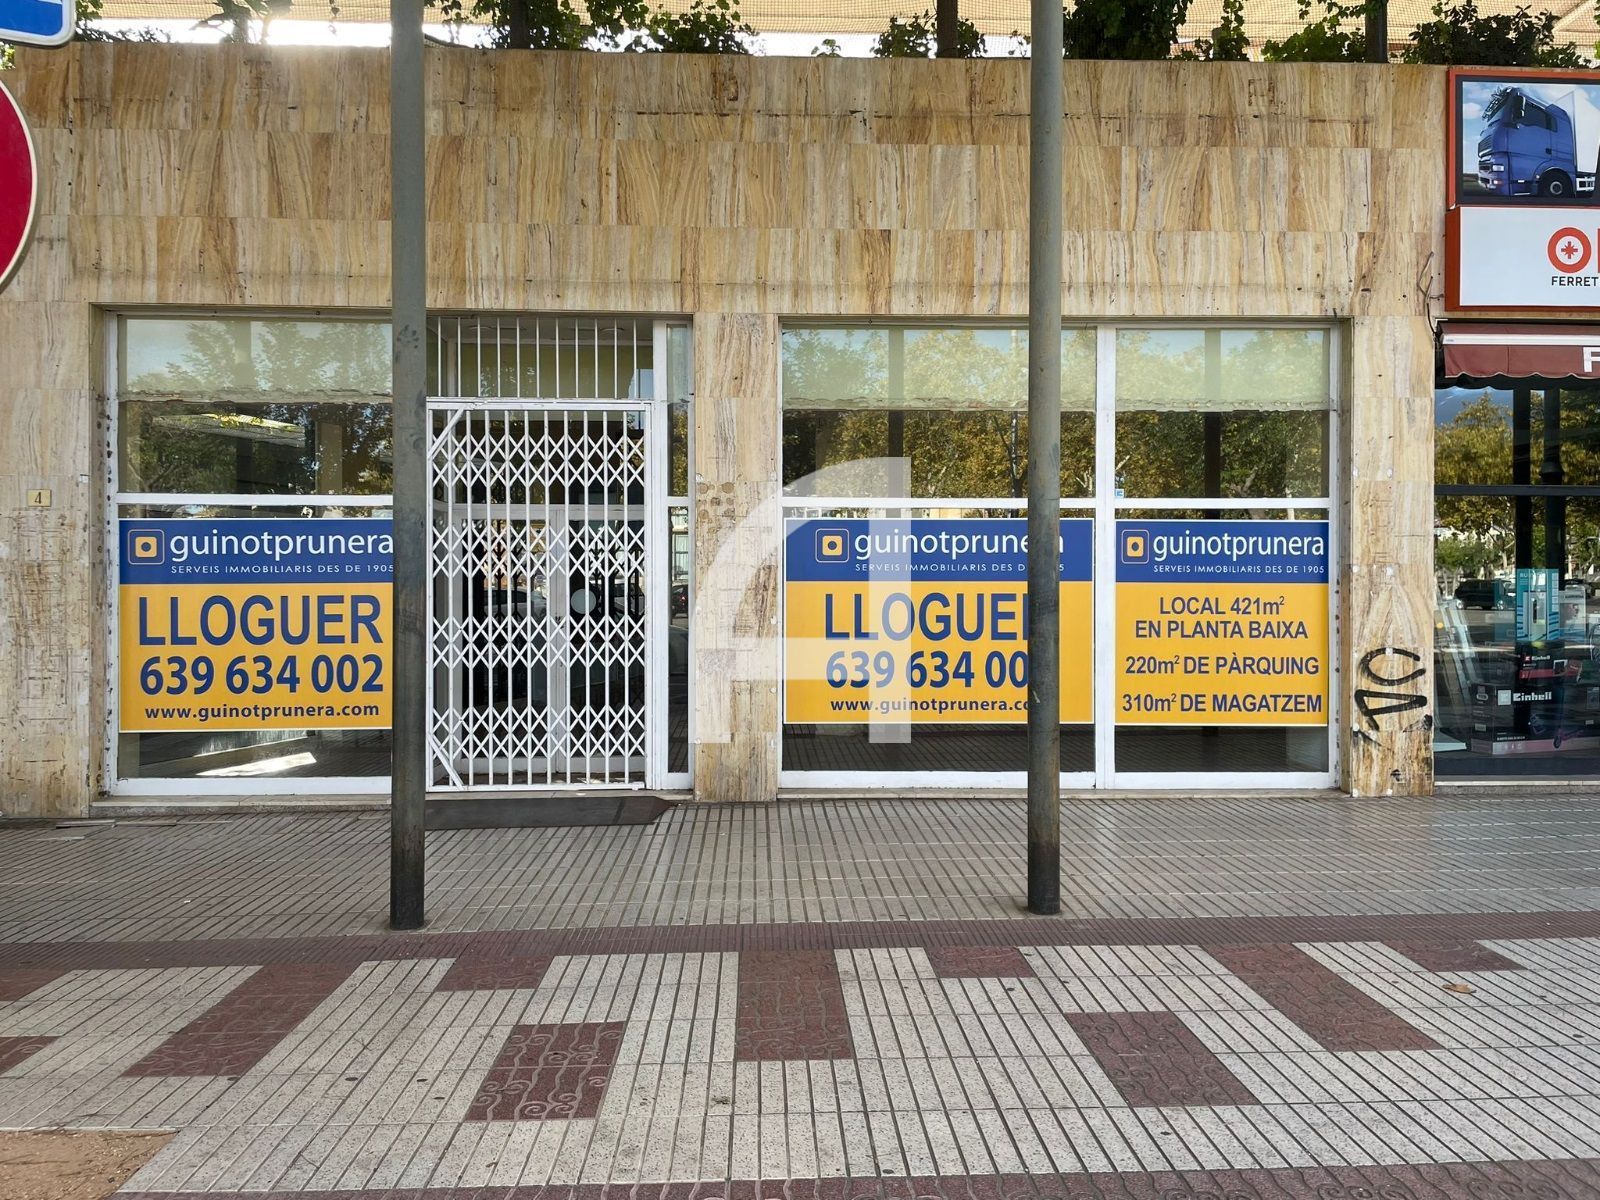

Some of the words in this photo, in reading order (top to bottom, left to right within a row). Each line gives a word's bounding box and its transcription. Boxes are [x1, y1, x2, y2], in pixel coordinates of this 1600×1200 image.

[35, 492, 41, 504] 4
[171, 529, 393, 561] guinotprunera
[853, 528, 1064, 561] guinotprun
[1154, 530, 1323, 561] guinotprunera
[171, 565, 220, 574] SERVEIS
[225, 565, 313, 573] IMMOBILIARIS
[317, 564, 340, 573] DES
[345, 564, 361, 573] DE
[367, 564, 394, 573] 1905
[855, 562, 902, 573] SERVEIS
[903, 562, 987, 573] IMMOBILIARIS
[991, 563, 1013, 572] DES
[1153, 564, 1191, 573] SERVEIS
[1194, 565, 1261, 573] IMMOBILIARIS
[1265, 565, 1283, 574] DES
[1286, 565, 1299, 574] DE
[1303, 565, 1324, 574] 1905
[1159, 596, 1226, 615] LOCAL
[139, 595, 383, 645] LLOGUER
[825, 592, 1028, 641] LLOGUE
[1135, 620, 1161, 639] EN
[1167, 620, 1244, 639] PLANTA
[1248, 620, 1309, 639] BAIXA
[826, 650, 895, 688] 639
[906, 650, 975, 688] 634
[985, 650, 1028, 688] 00
[1183, 656, 1210, 675] DE
[1215, 652, 1319, 676] PÀRQUING
[140, 656, 214, 695] 639
[226, 655, 300, 694] 634
[312, 654, 383, 693] 002
[831, 698, 1028, 714] www.guinotprunera.c
[1180, 693, 1207, 712] DE
[1212, 693, 1322, 713] MAGATZEM
[1513, 691, 1552, 702] Einhell
[144, 703, 379, 722] www.guinotprunera.com
